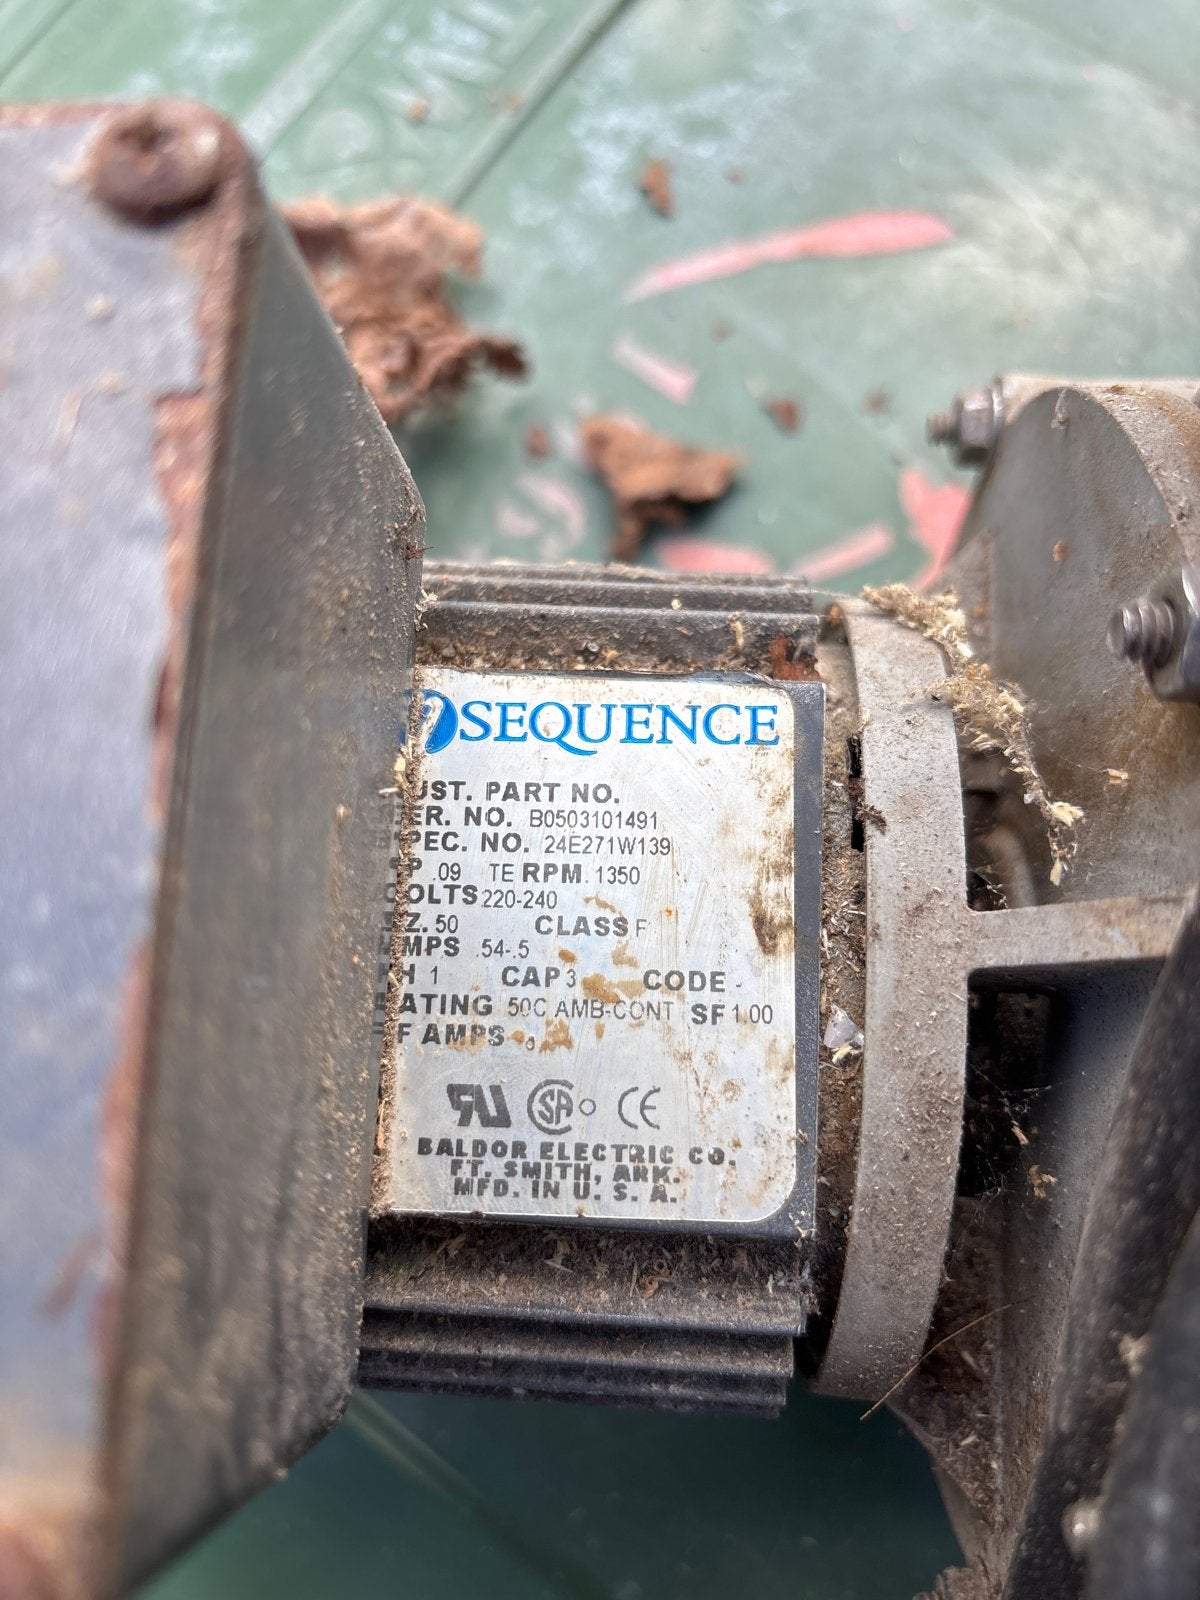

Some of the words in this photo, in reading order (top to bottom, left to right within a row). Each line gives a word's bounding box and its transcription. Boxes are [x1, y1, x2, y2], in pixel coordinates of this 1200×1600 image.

[460, 700, 780, 756] SEQUENCE
[486, 781, 560, 803] PART
[572, 783, 620, 805] NO.
[464, 806, 512, 827] NO.
[529, 809, 658, 830] B0503101491
[481, 832, 529, 853] NO.
[544, 836, 671, 857] 24E271W139
[489, 863, 514, 882] TE
[595, 865, 640, 885] 1350
[408, 884, 478, 905] OLTS
[435, 914, 459, 934] 50
[535, 914, 629, 937] CLASS
[430, 965, 438, 985] 1
[501, 965, 560, 988] CAP
[565, 967, 576, 989] 3
[643, 969, 726, 993] CODE
[400, 992, 492, 1016] ATING
[554, 998, 675, 1021] AMB-CONT
[691, 1003, 725, 1025] SF
[421, 1023, 505, 1047] AMPS
[617, 1085, 661, 1130] CE
[417, 1136, 527, 1159] BALDOR
[539, 1142, 674, 1164] ELECTRIC
[688, 1146, 736, 1166] CO.
[450, 1159, 491, 1178] FT.
[504, 1160, 602, 1184] SMITH,
[613, 1164, 681, 1184] ARK.
[453, 1176, 520, 1198] MFD.
[531, 1180, 560, 1199] IN
